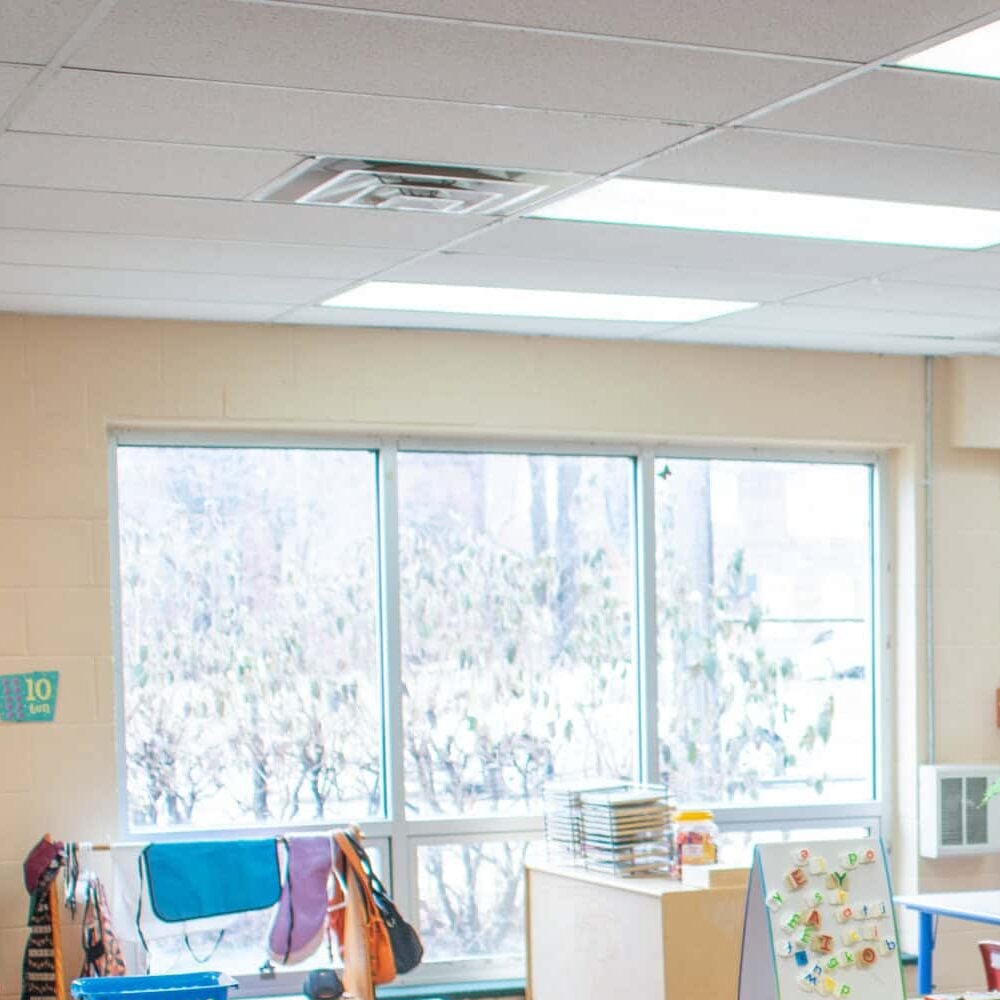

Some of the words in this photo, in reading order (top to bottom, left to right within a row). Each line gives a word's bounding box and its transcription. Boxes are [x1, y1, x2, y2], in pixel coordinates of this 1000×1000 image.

[25, 678, 51, 701] 10
[834, 871, 847, 887] Y
[809, 909, 820, 926] A
[862, 947, 877, 964] O
